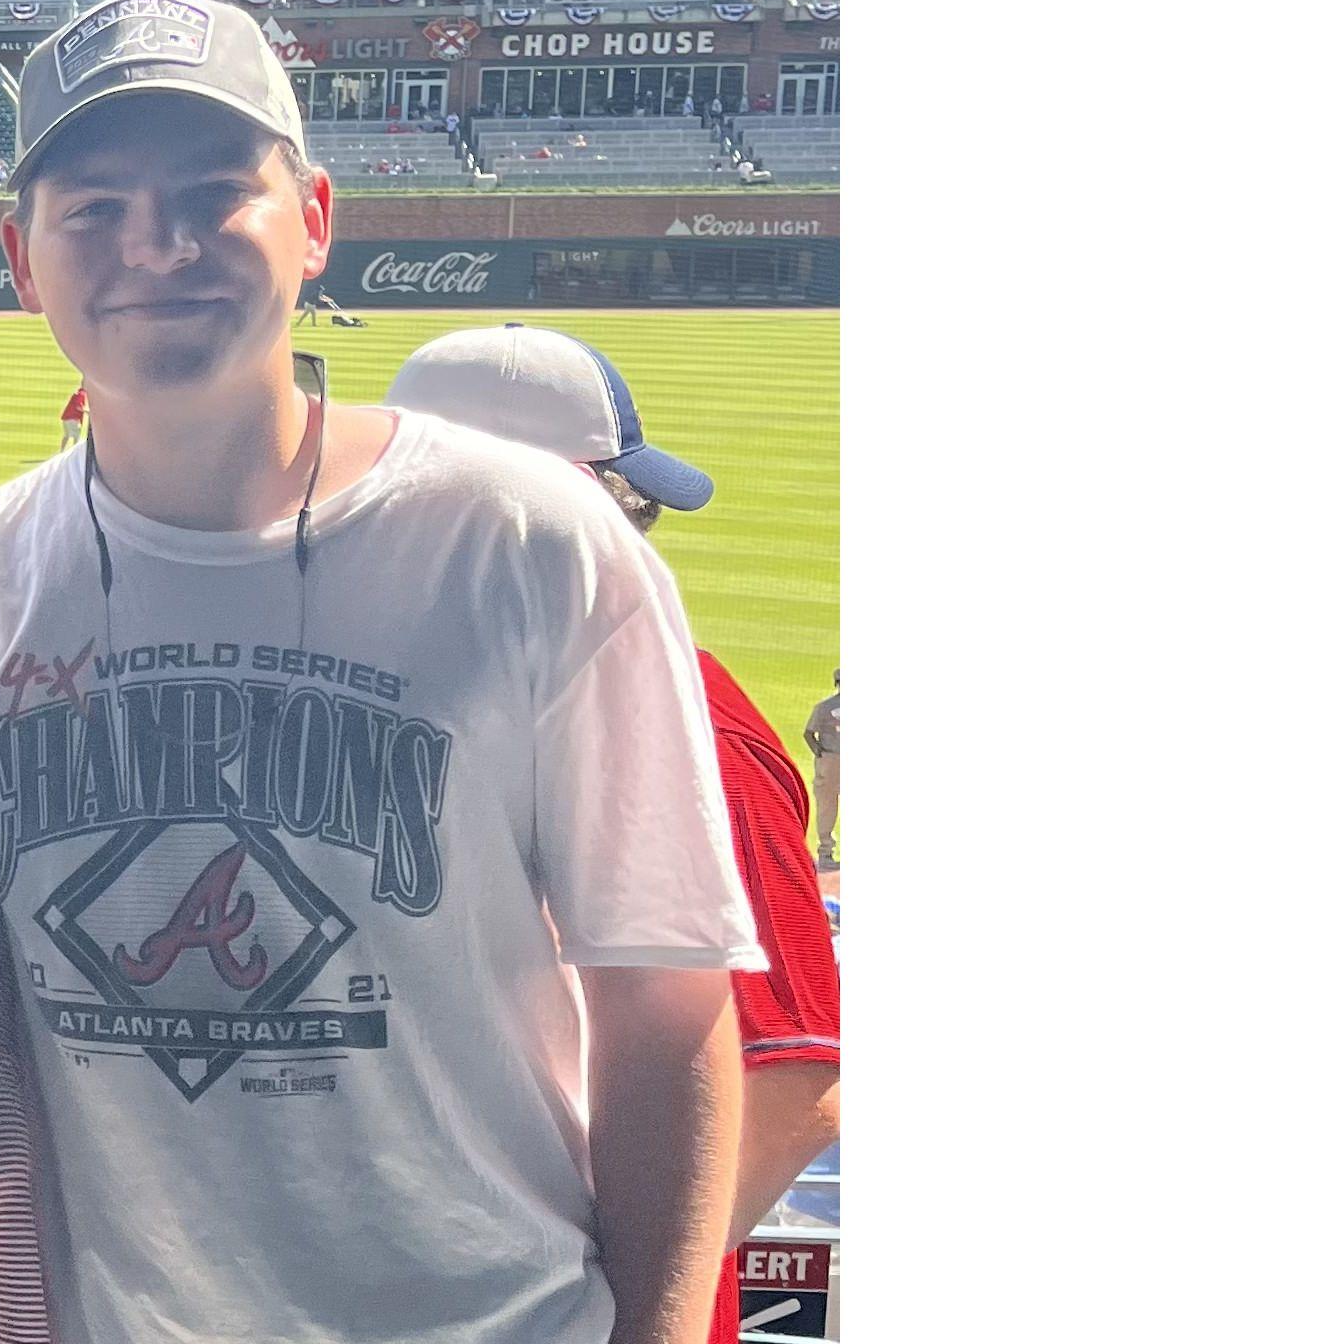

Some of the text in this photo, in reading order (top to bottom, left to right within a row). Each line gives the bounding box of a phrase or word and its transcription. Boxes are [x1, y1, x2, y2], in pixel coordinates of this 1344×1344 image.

[268, 39, 411, 62] oors LIGHT
[502, 30, 716, 57] CHOP HOUSE
[693, 213, 822, 237] Coors LIGHT
[360, 251, 499, 295] Coca-Cola
[95, 642, 240, 681] WORLD
[250, 644, 403, 702] SERIES
[58, 1010, 344, 1043] ATLANTA BRAVES
[240, 1074, 337, 1093] WORLD SERIES
[739, 1251, 814, 1282] ERT
